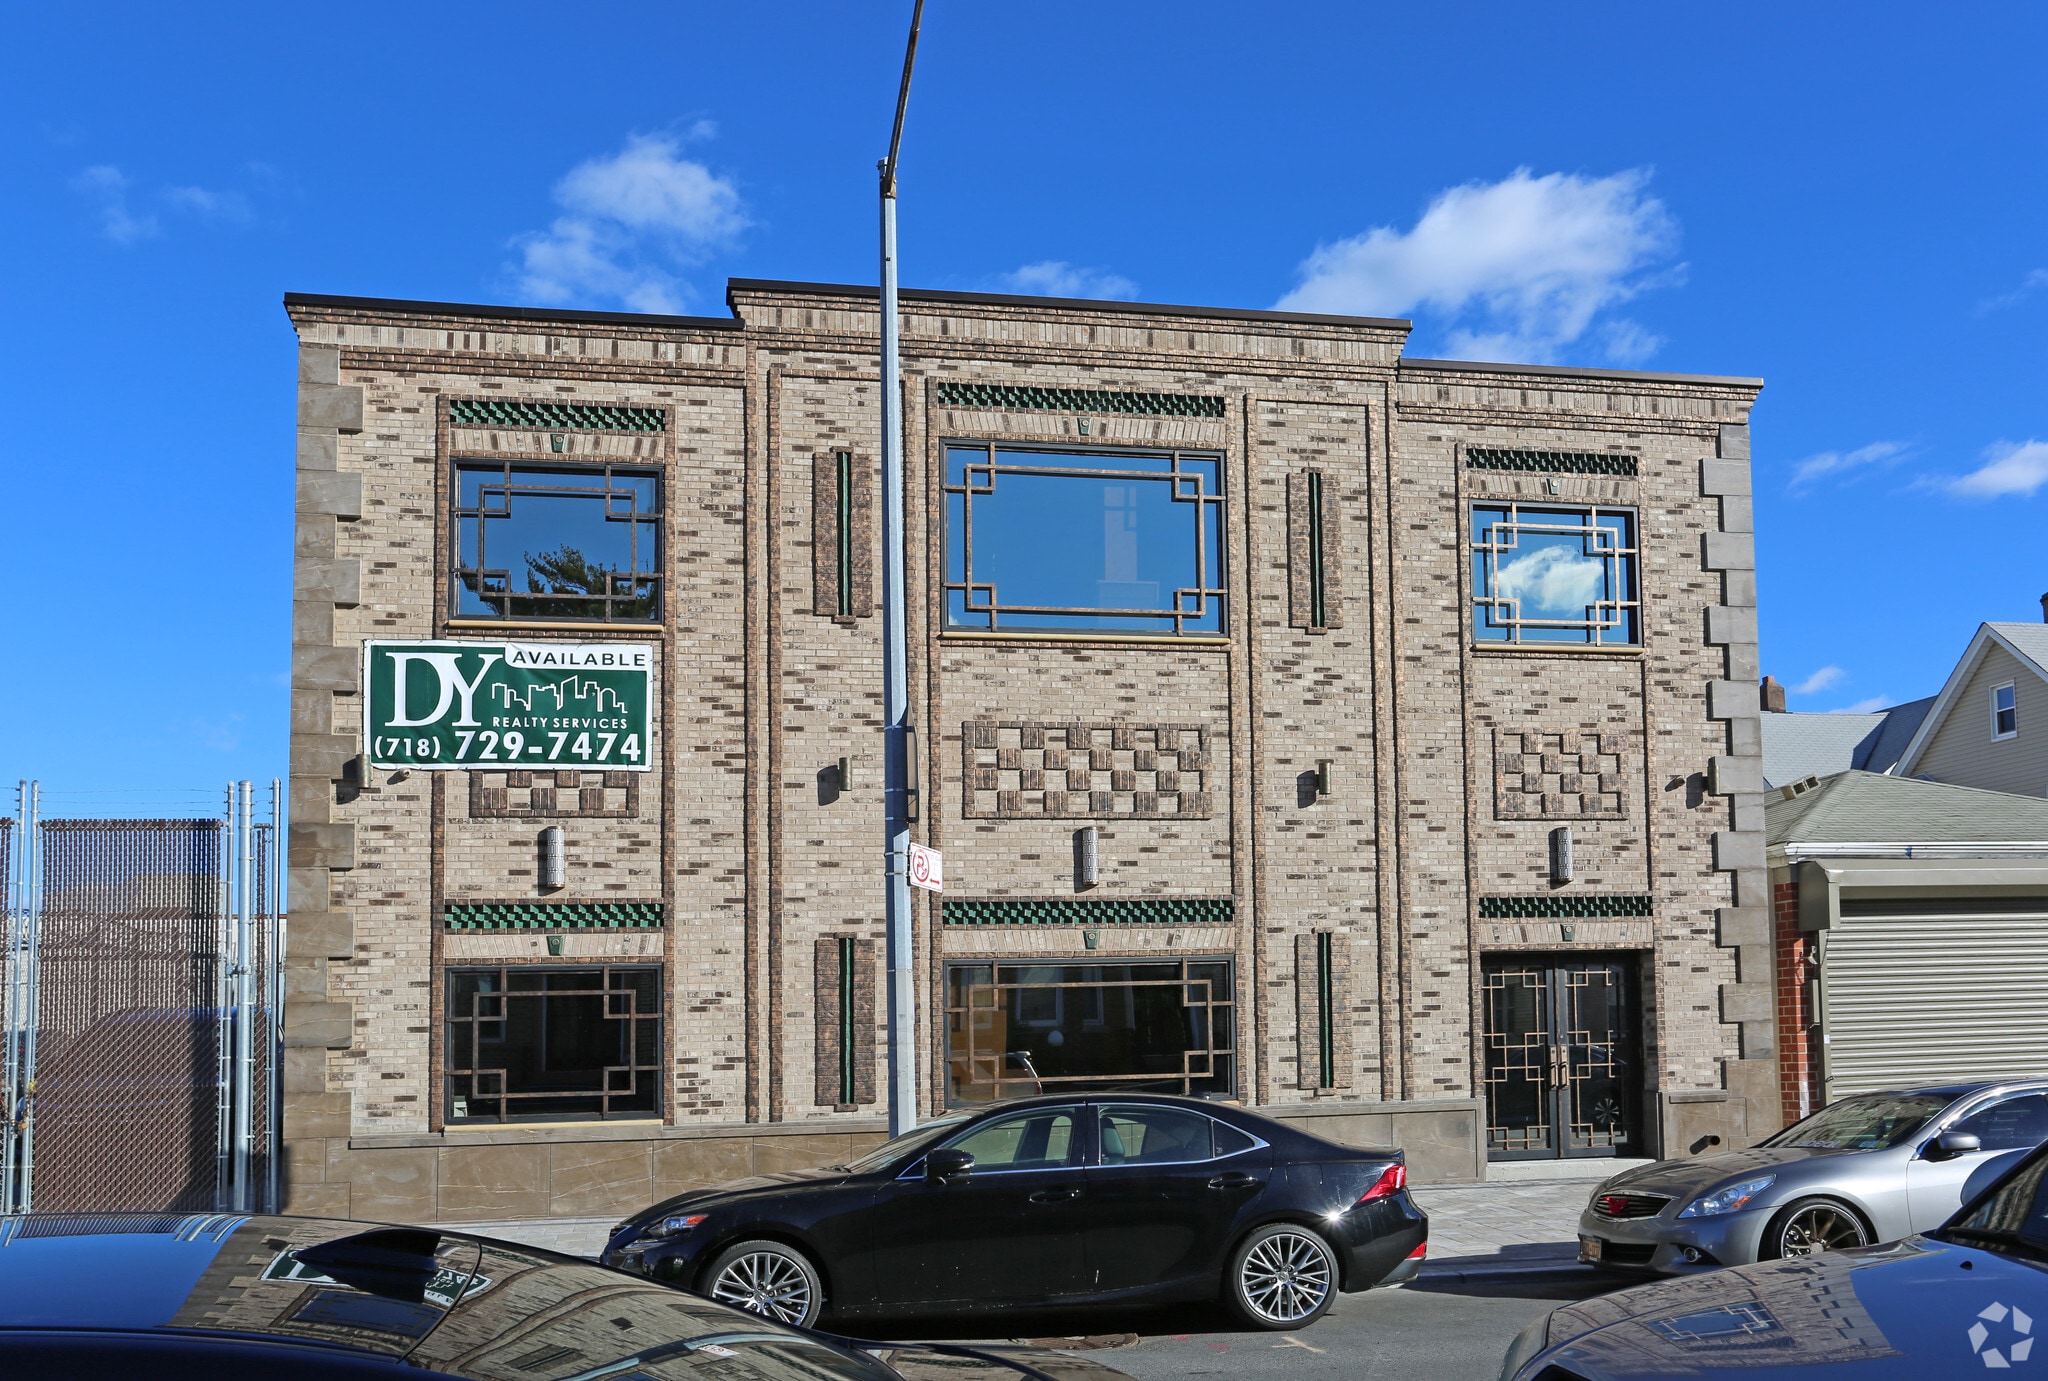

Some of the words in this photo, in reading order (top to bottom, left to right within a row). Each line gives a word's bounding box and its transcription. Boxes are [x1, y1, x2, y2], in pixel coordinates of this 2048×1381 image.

[512, 650, 646, 667] AVAILABLE
[384, 651, 504, 728] DY
[492, 716, 548, 728] REALTY
[553, 717, 628, 730] SERVICES
[374, 735, 441, 759] (718)
[454, 730, 641, 762] 729-7474
